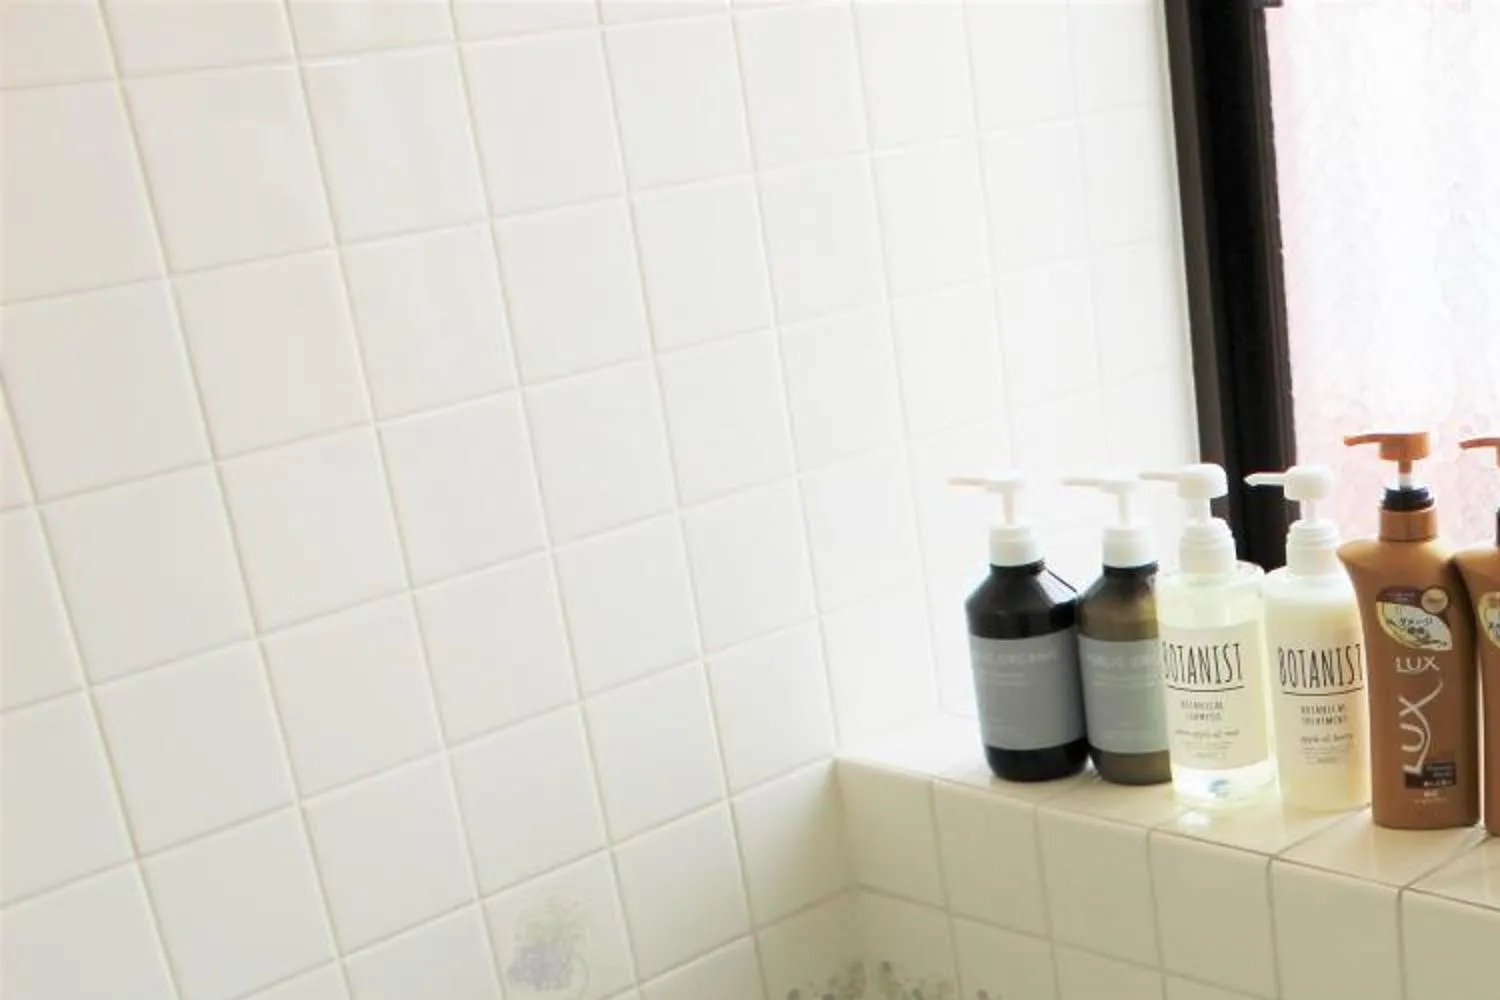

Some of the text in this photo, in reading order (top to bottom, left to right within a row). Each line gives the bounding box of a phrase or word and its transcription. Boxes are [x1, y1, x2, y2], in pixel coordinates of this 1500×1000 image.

[1278, 643, 1363, 689] BOTANIST
[1396, 655, 1440, 673] LUX
[1399, 680, 1444, 775] LUX
